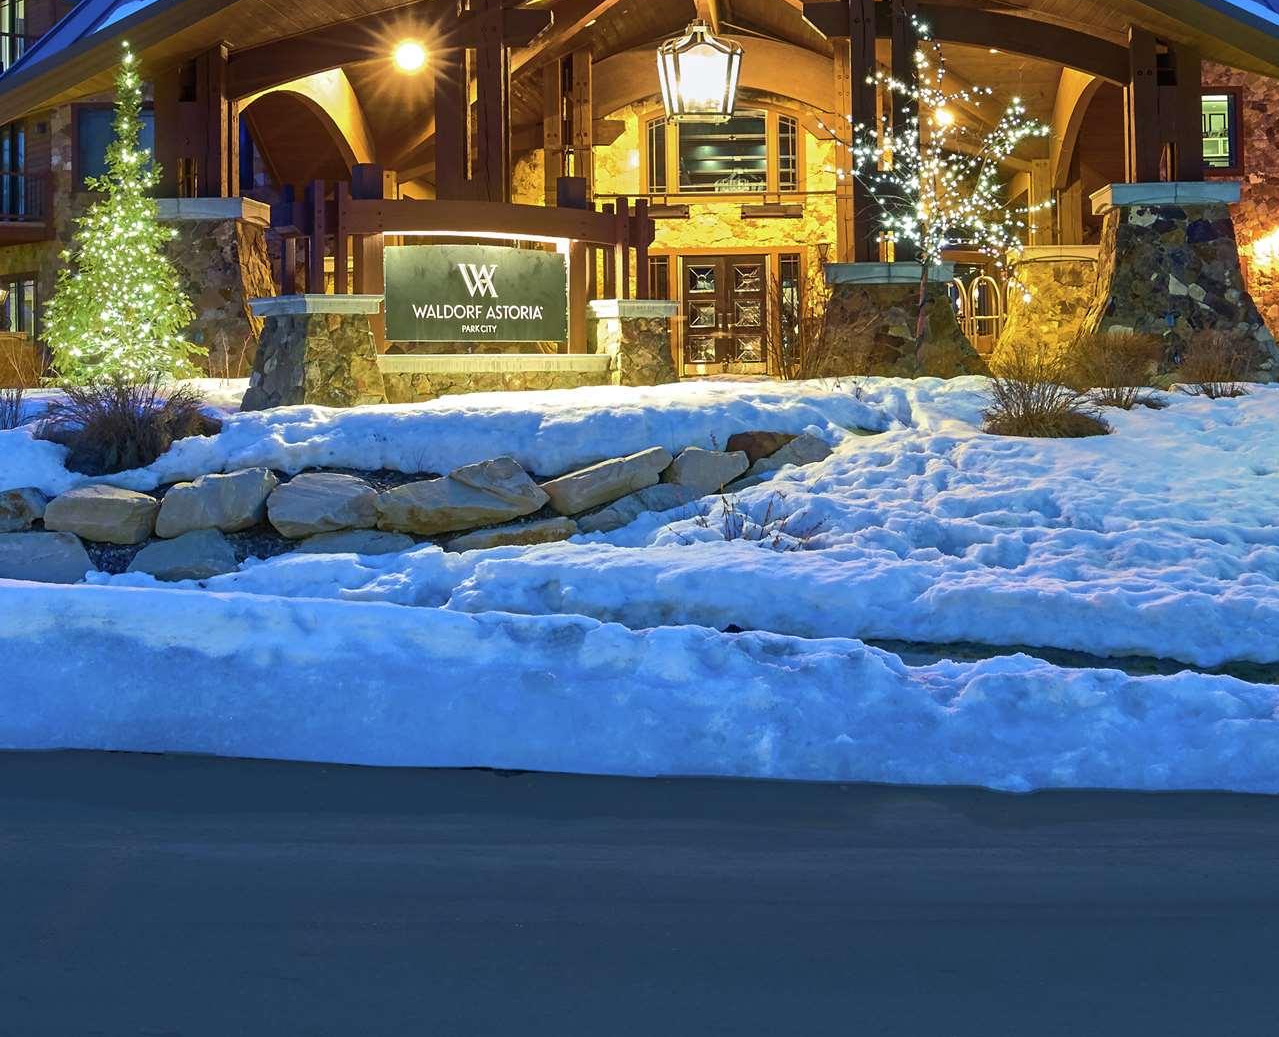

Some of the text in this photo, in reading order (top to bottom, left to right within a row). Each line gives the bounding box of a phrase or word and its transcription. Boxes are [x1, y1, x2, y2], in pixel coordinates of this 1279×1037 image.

[412, 304, 543, 320] WALDORF ASTORIA
[461, 324, 497, 333] PARK CITY
